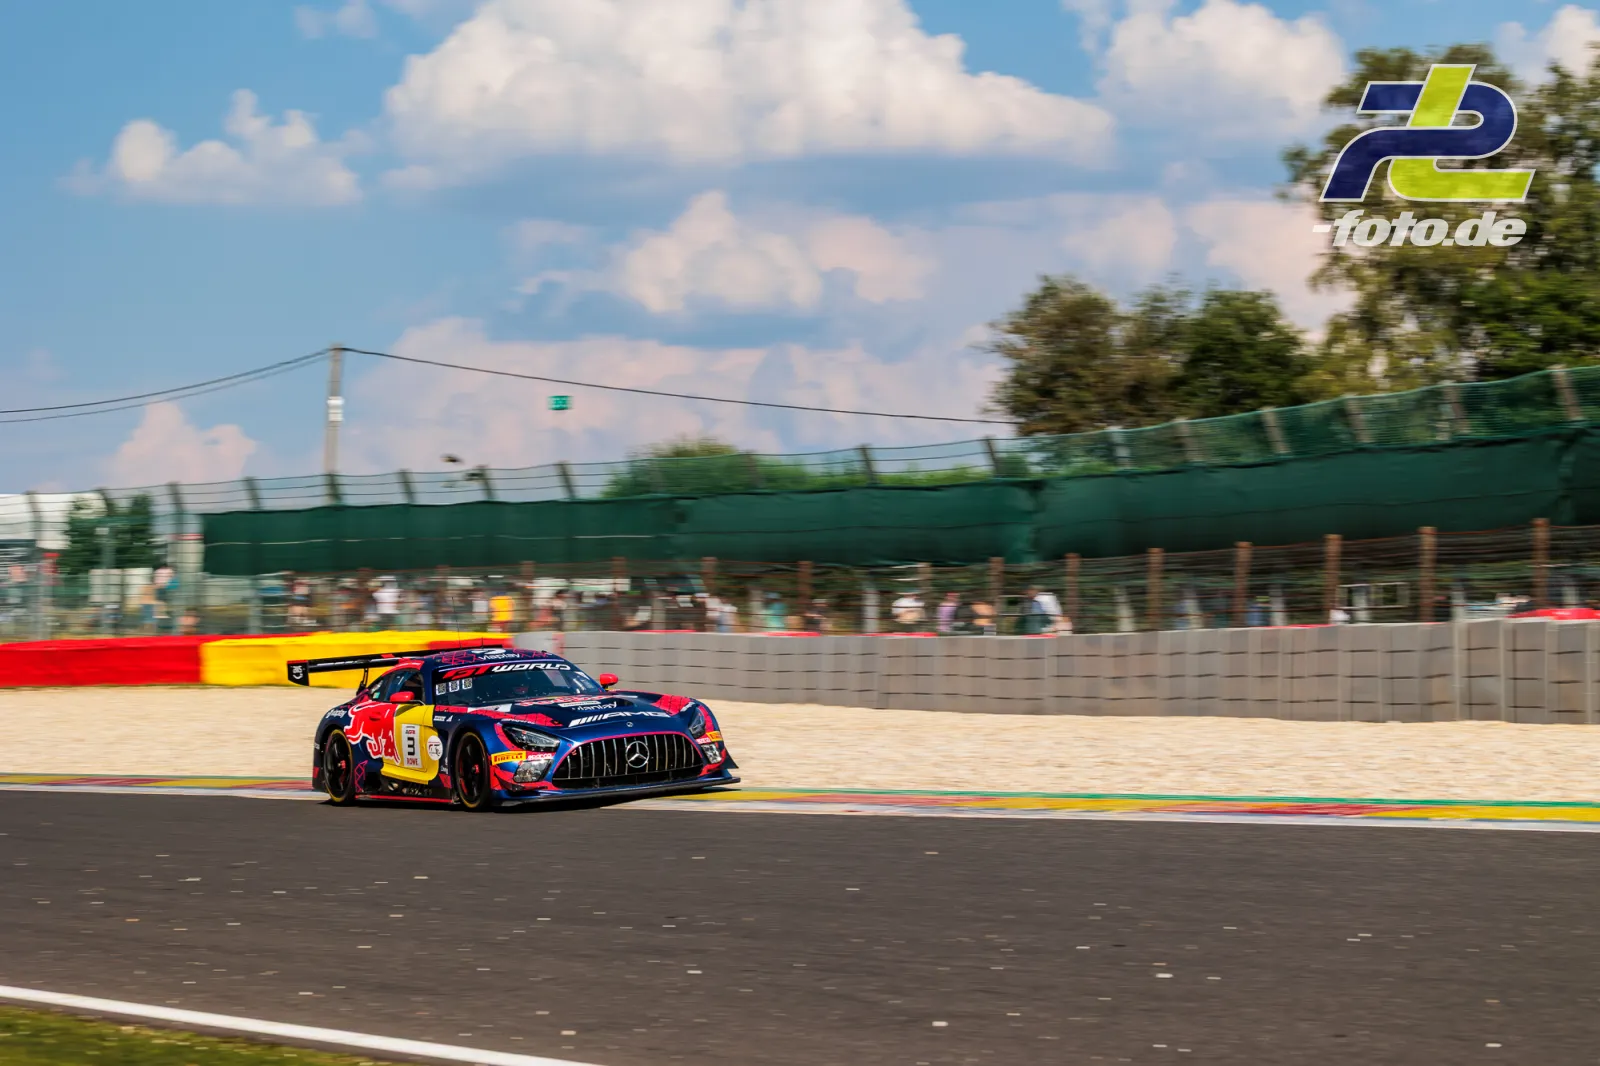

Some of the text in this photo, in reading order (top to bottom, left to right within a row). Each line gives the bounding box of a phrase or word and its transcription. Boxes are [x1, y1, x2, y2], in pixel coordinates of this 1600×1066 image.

[443, 663, 571, 680] GT WORLD
[407, 736, 415, 756] 3
[494, 752, 523, 763] PIRELLI
